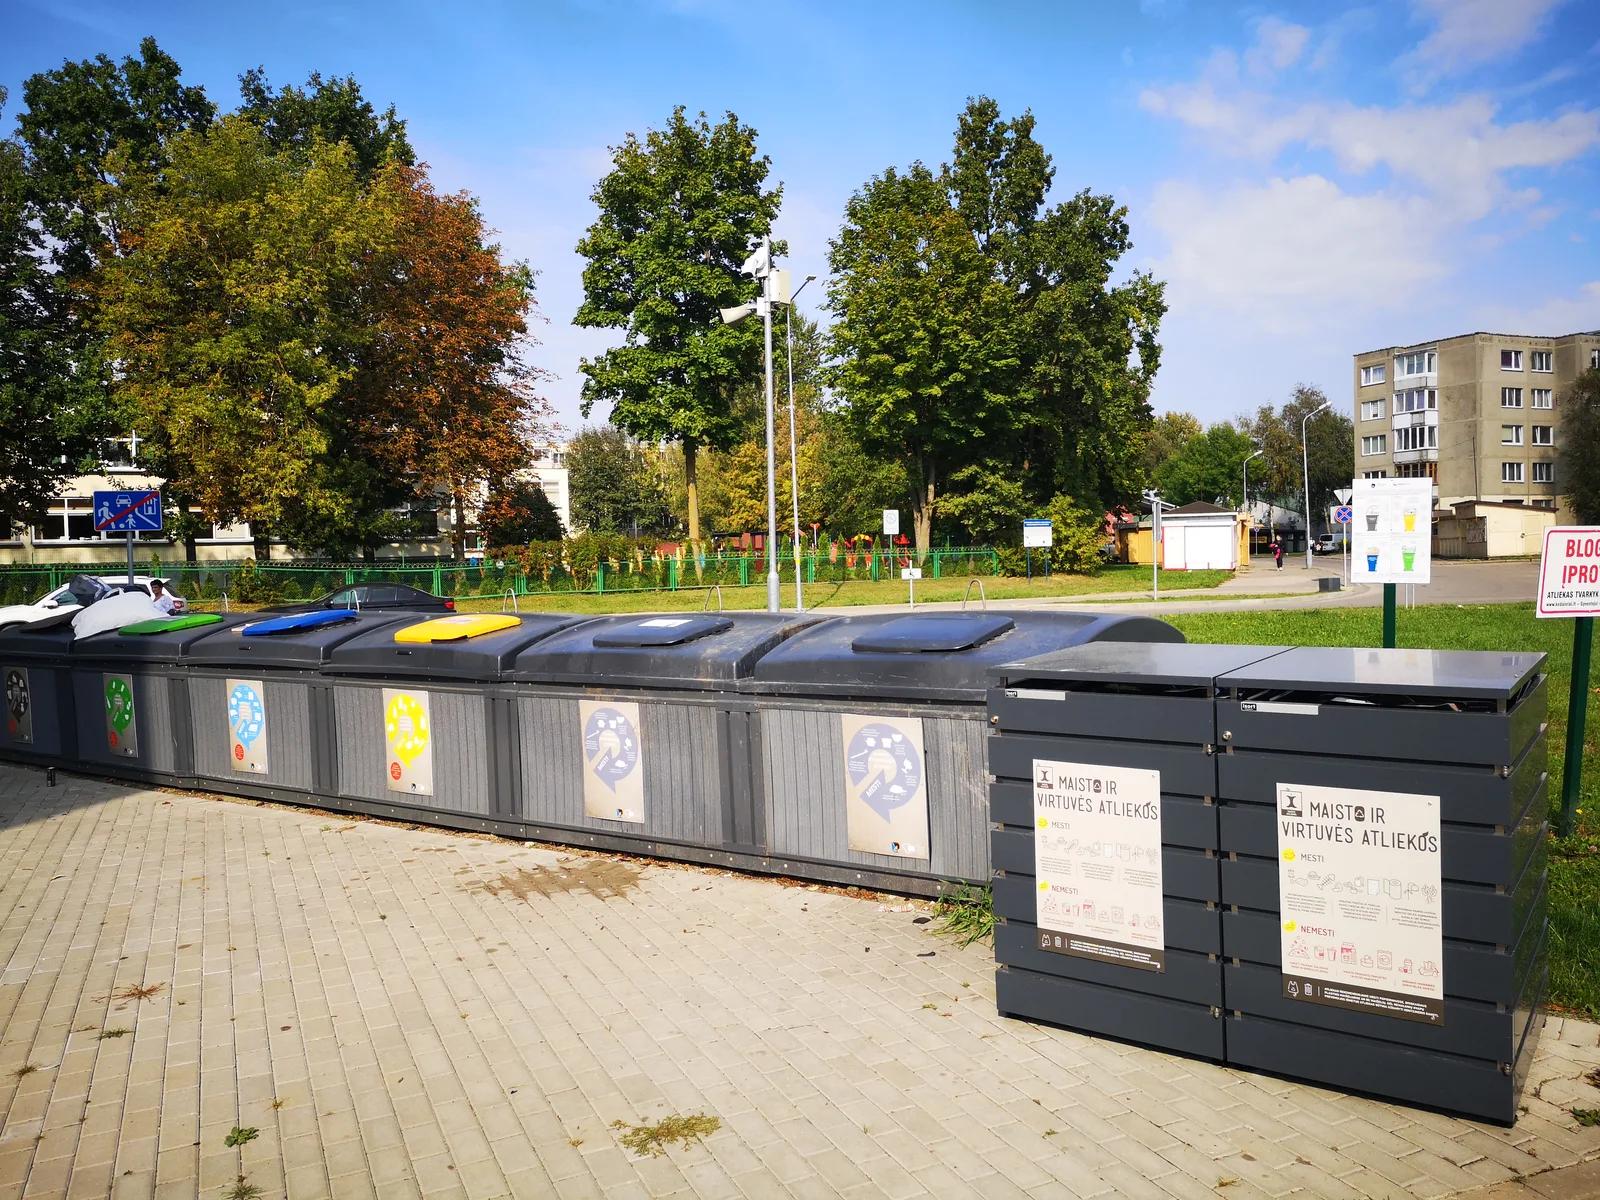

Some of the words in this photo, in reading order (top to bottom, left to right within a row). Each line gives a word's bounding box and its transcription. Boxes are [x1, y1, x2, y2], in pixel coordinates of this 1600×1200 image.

[1562, 564, 1600, 588] ĮPRO
[1547, 591, 1574, 599] ATLIEKAS
[1058, 776, 1102, 794] MAISTO
[1105, 780, 1118, 795] IR
[1037, 792, 1093, 813] VIRTUVĖS
[1099, 800, 1158, 821] ATLIEKOS
[1310, 801, 1365, 822] MAISTO
[1371, 807, 1386, 824] IR
[1051, 821, 1070, 830] MESTI
[1281, 821, 1354, 844] VIRTUVĖS
[1361, 829, 1438, 853] ATLIEKOS
[1300, 853, 1324, 863] MESTI
[1051, 885, 1079, 896] NEMESTI
[1300, 925, 1335, 937] NEMESTI
